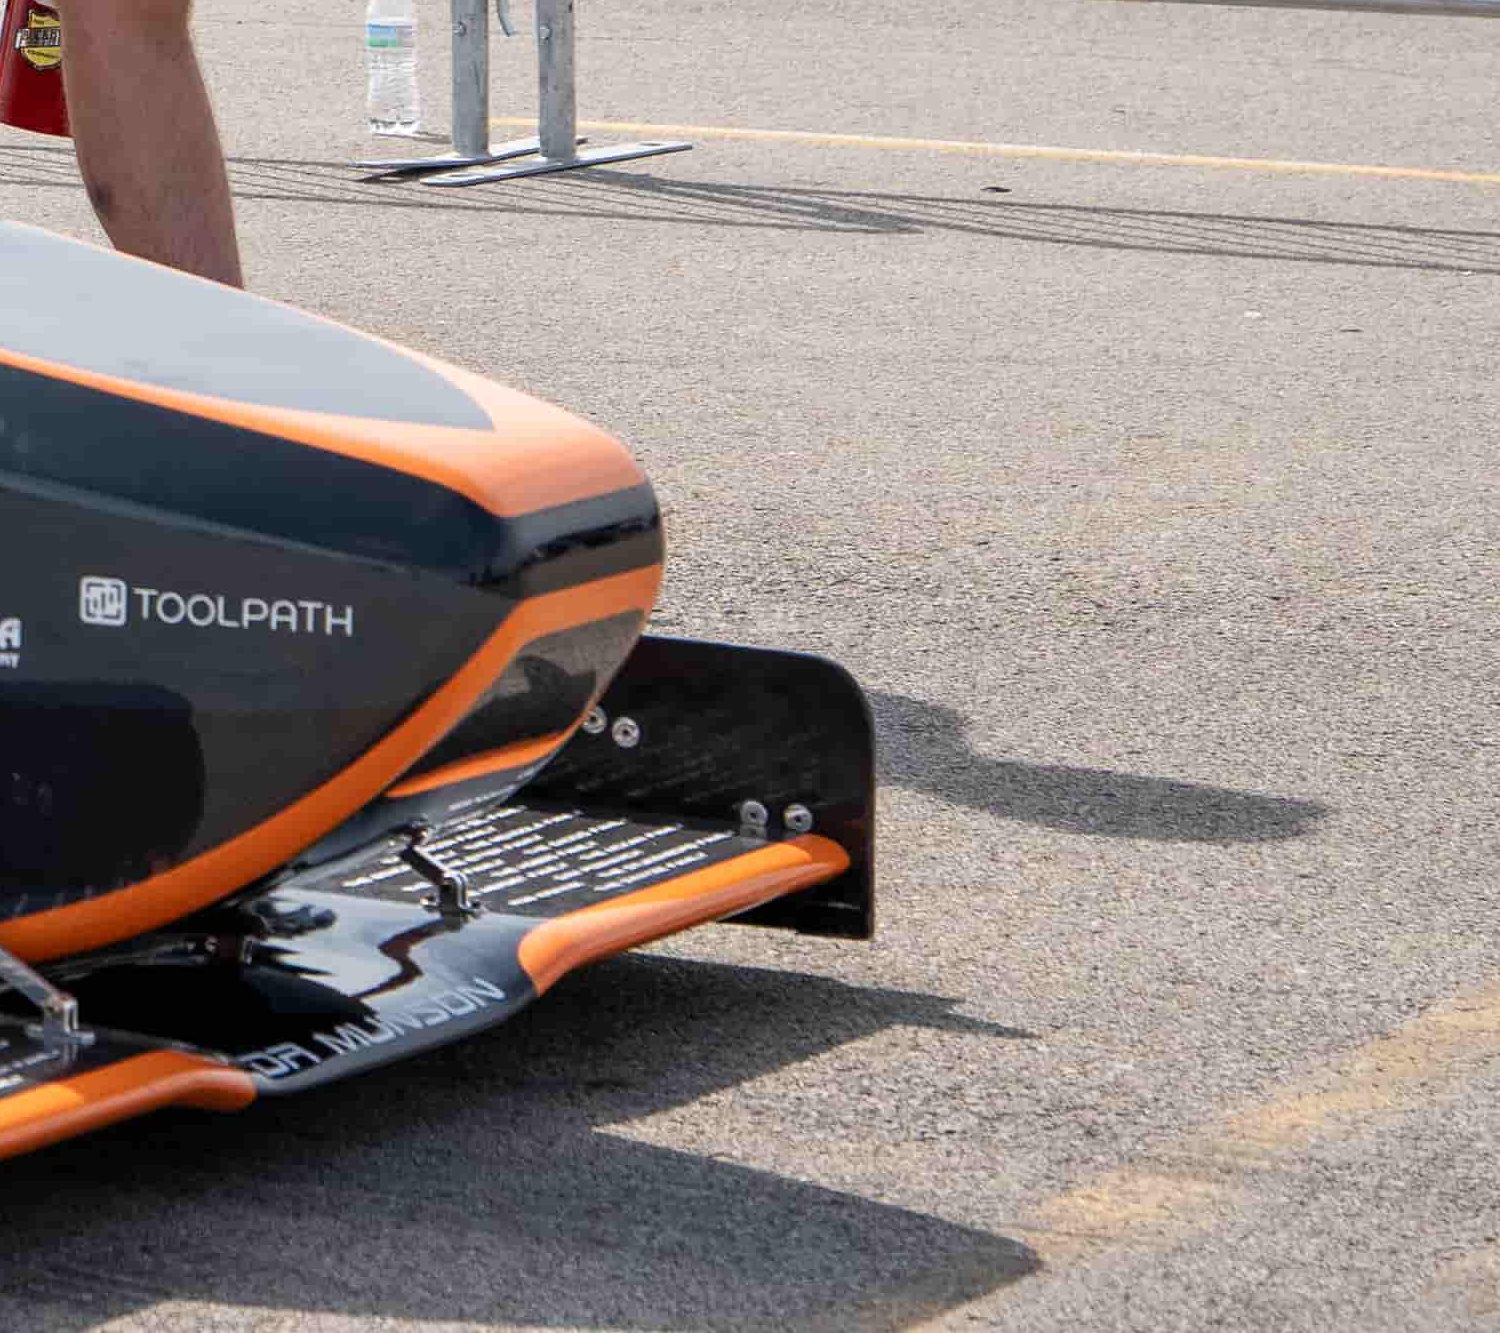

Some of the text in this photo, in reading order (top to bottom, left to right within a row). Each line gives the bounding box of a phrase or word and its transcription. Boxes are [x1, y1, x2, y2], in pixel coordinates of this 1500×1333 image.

[133, 587, 354, 636] TOOLPATH
[238, 975, 507, 1080] DR MUNSON
